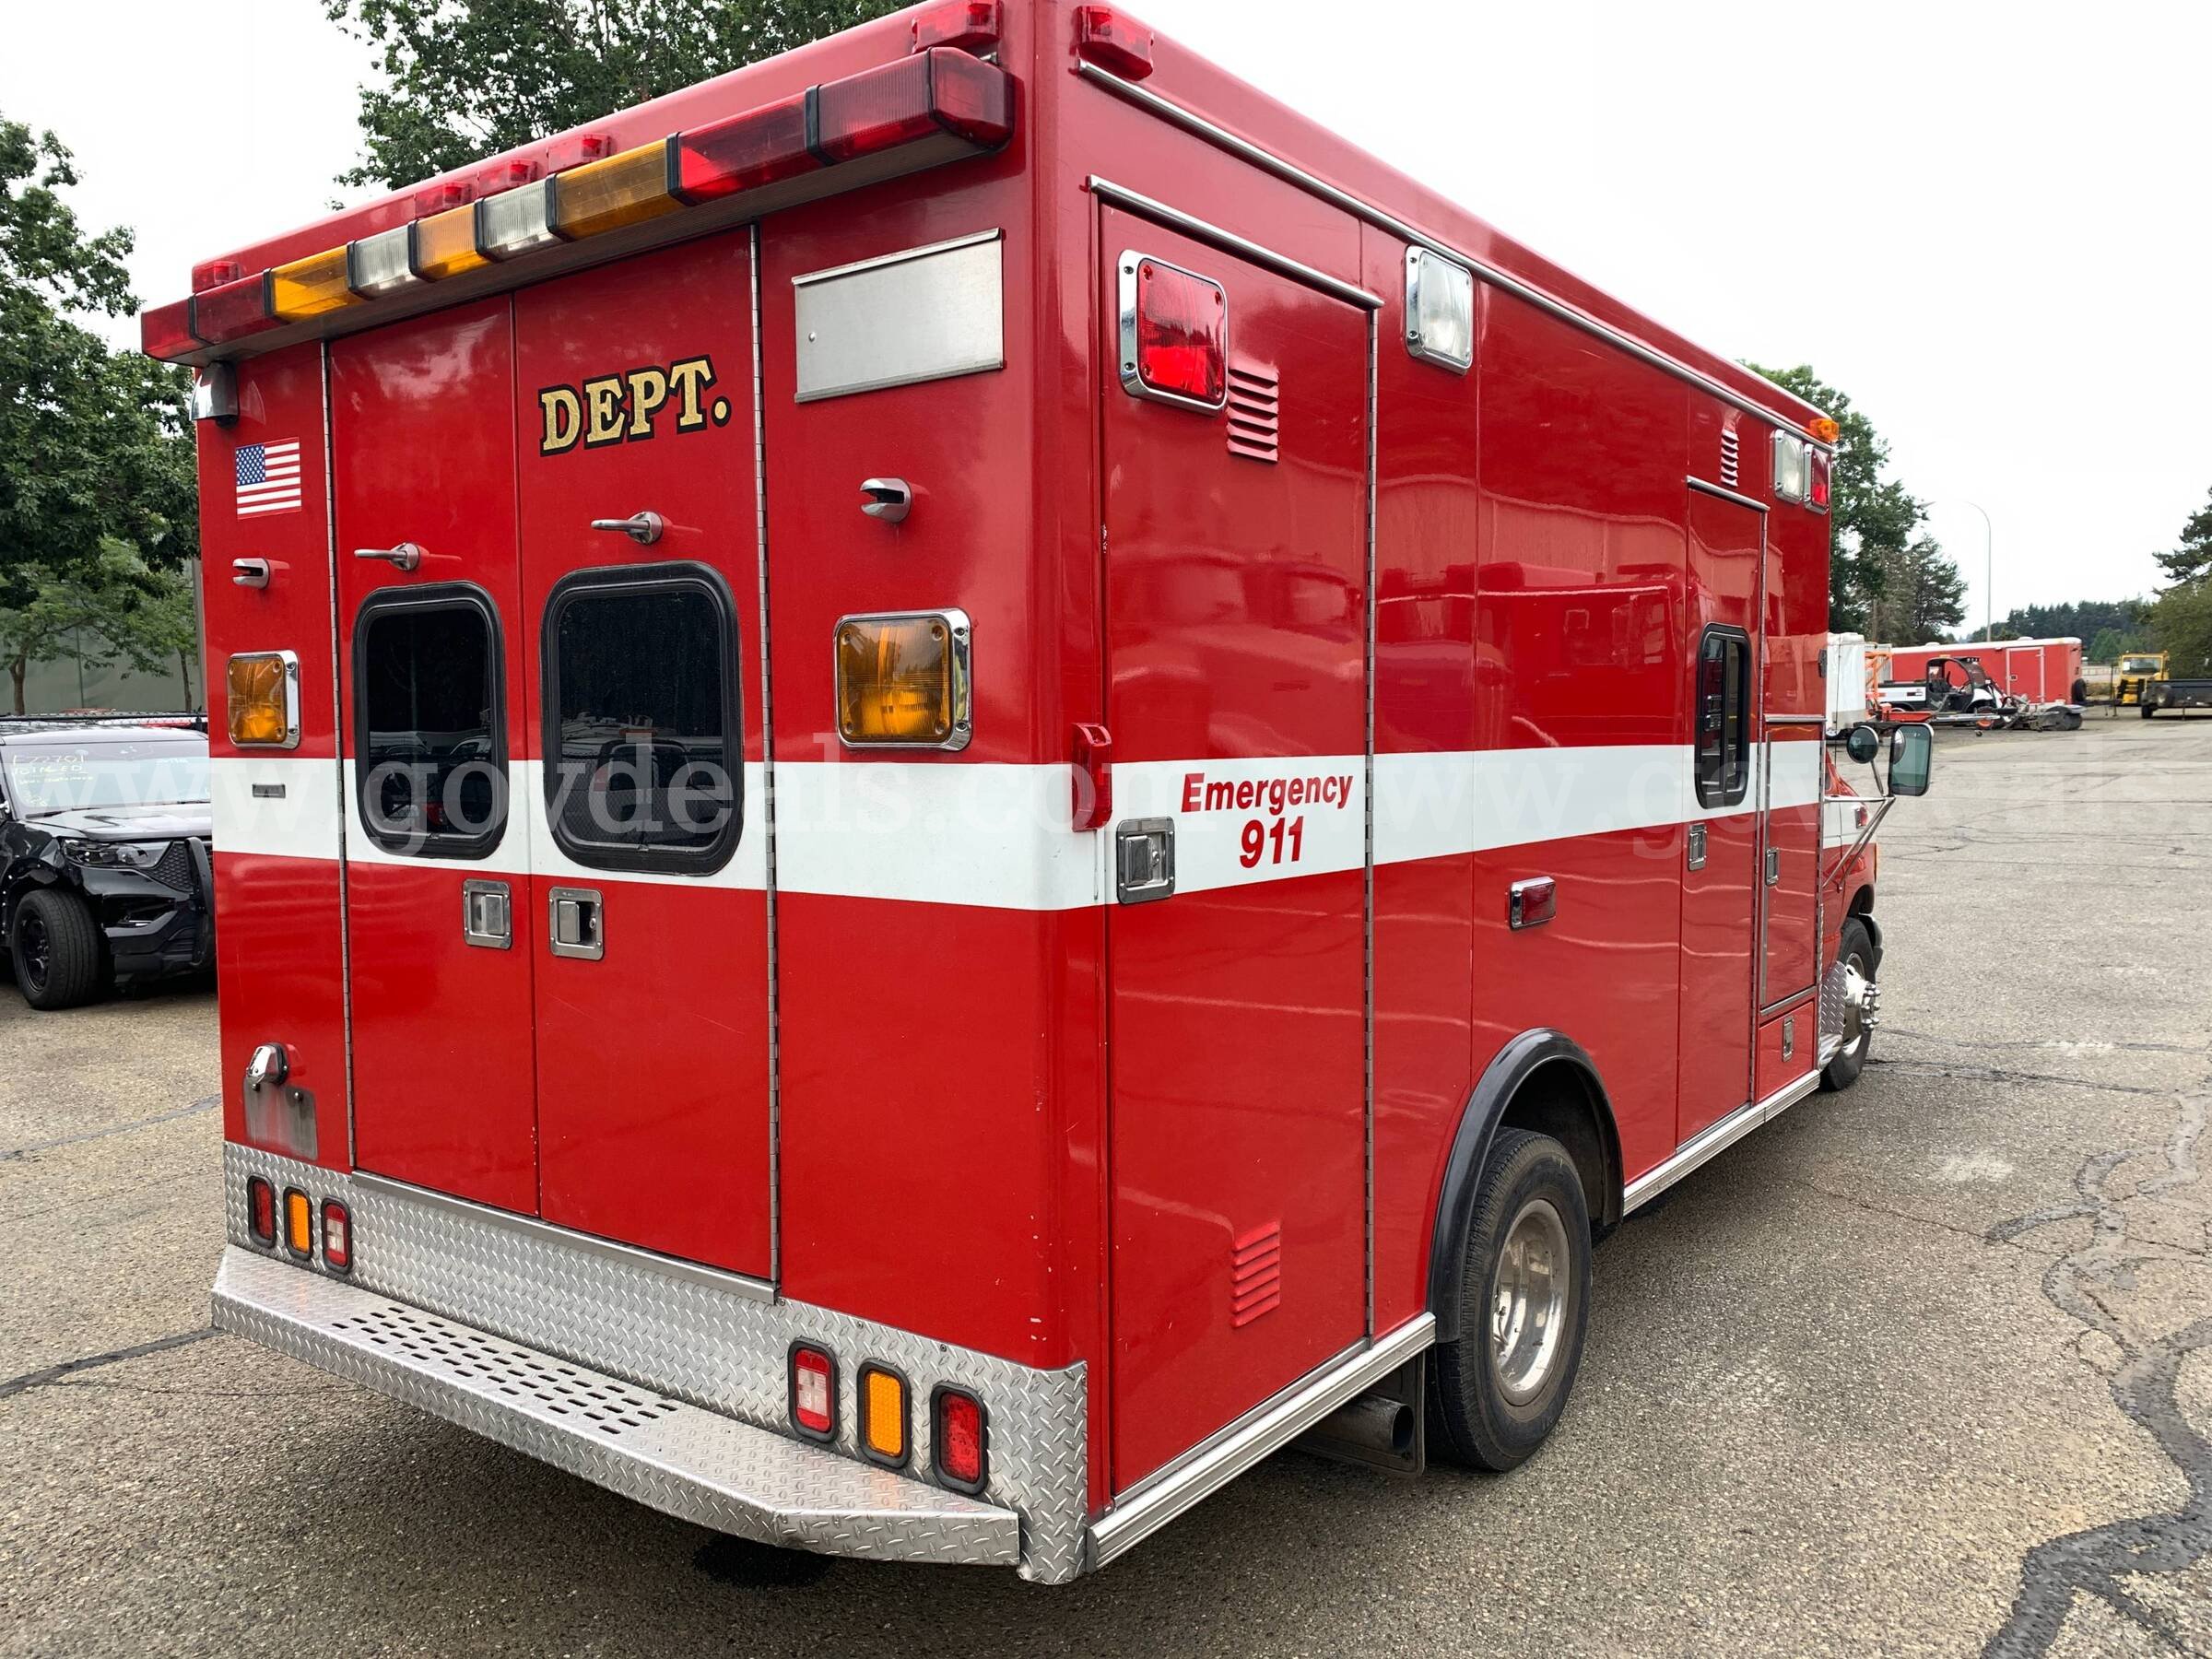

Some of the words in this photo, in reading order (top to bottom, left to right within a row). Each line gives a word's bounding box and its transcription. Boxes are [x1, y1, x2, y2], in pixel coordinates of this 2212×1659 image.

[538, 354, 732, 457] DEPT.
[1182, 772, 1353, 816] Emergency
[1240, 816, 1304, 868] 911
